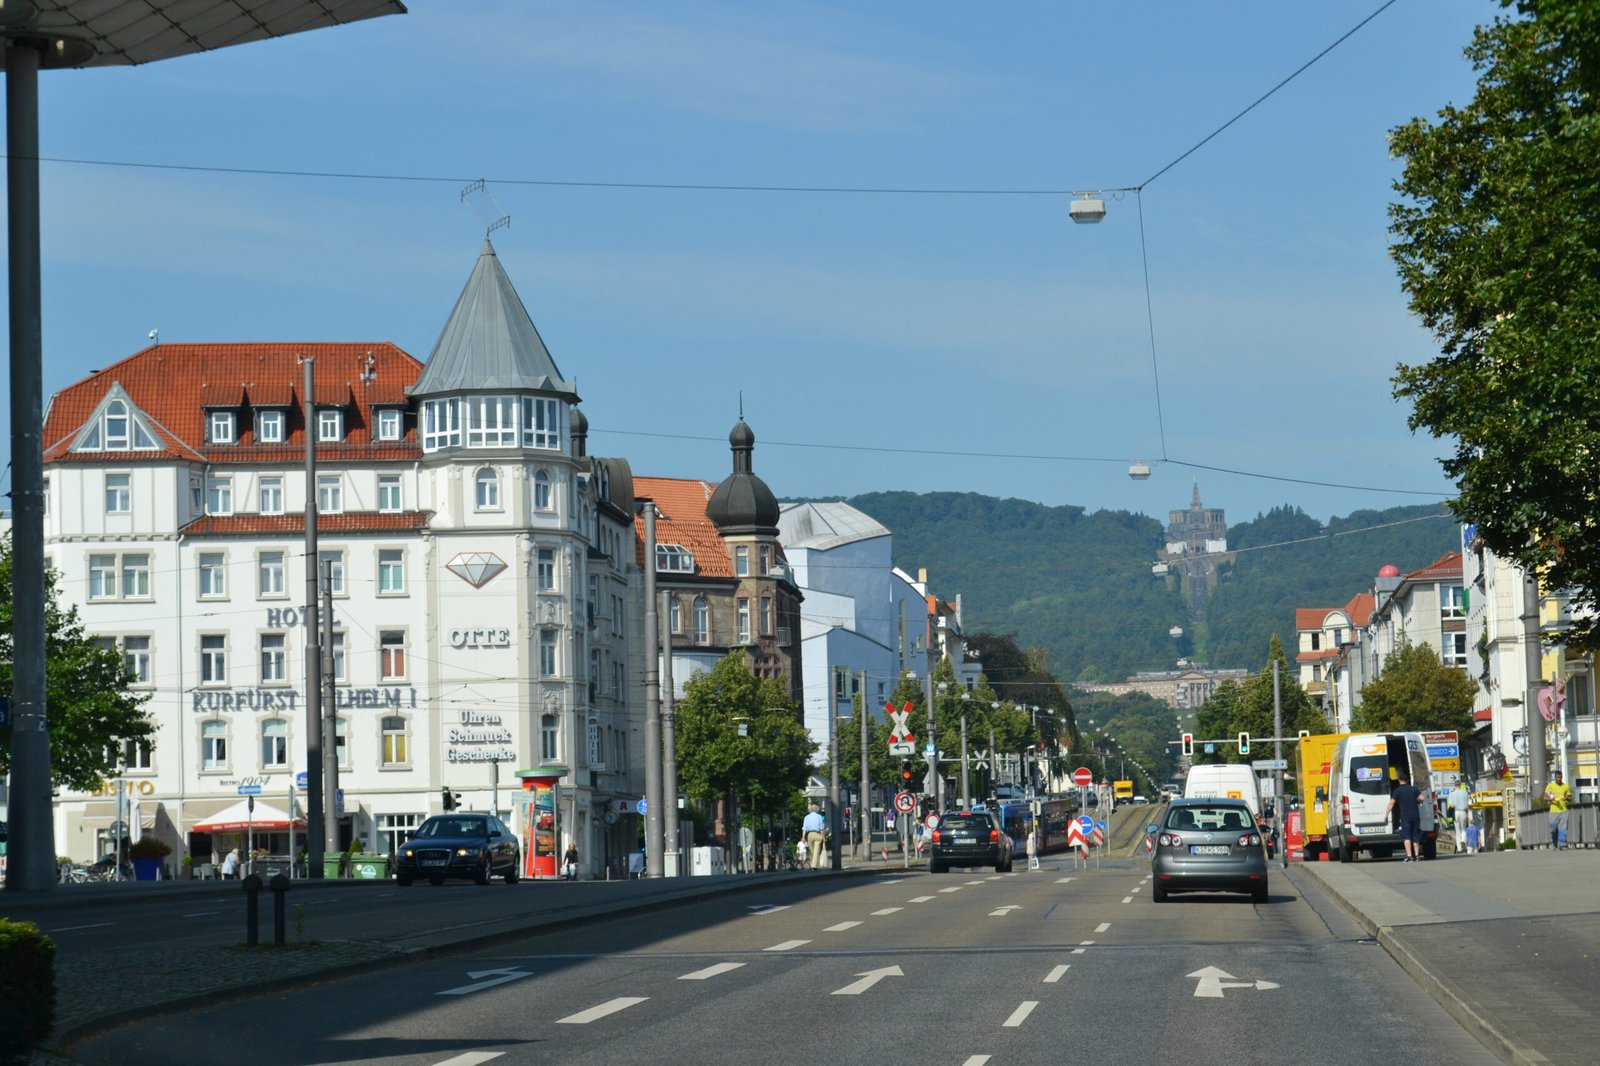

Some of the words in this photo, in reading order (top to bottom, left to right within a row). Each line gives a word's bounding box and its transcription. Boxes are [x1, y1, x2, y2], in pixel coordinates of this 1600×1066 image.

[449, 627, 510, 649] OTTE
[193, 689, 299, 712] KURFÜRST
[459, 710, 501, 726] Uhren
[449, 729, 512, 744] Schmuck
[448, 746, 516, 764] Geschenke
[241, 775, 271, 786] 1904
